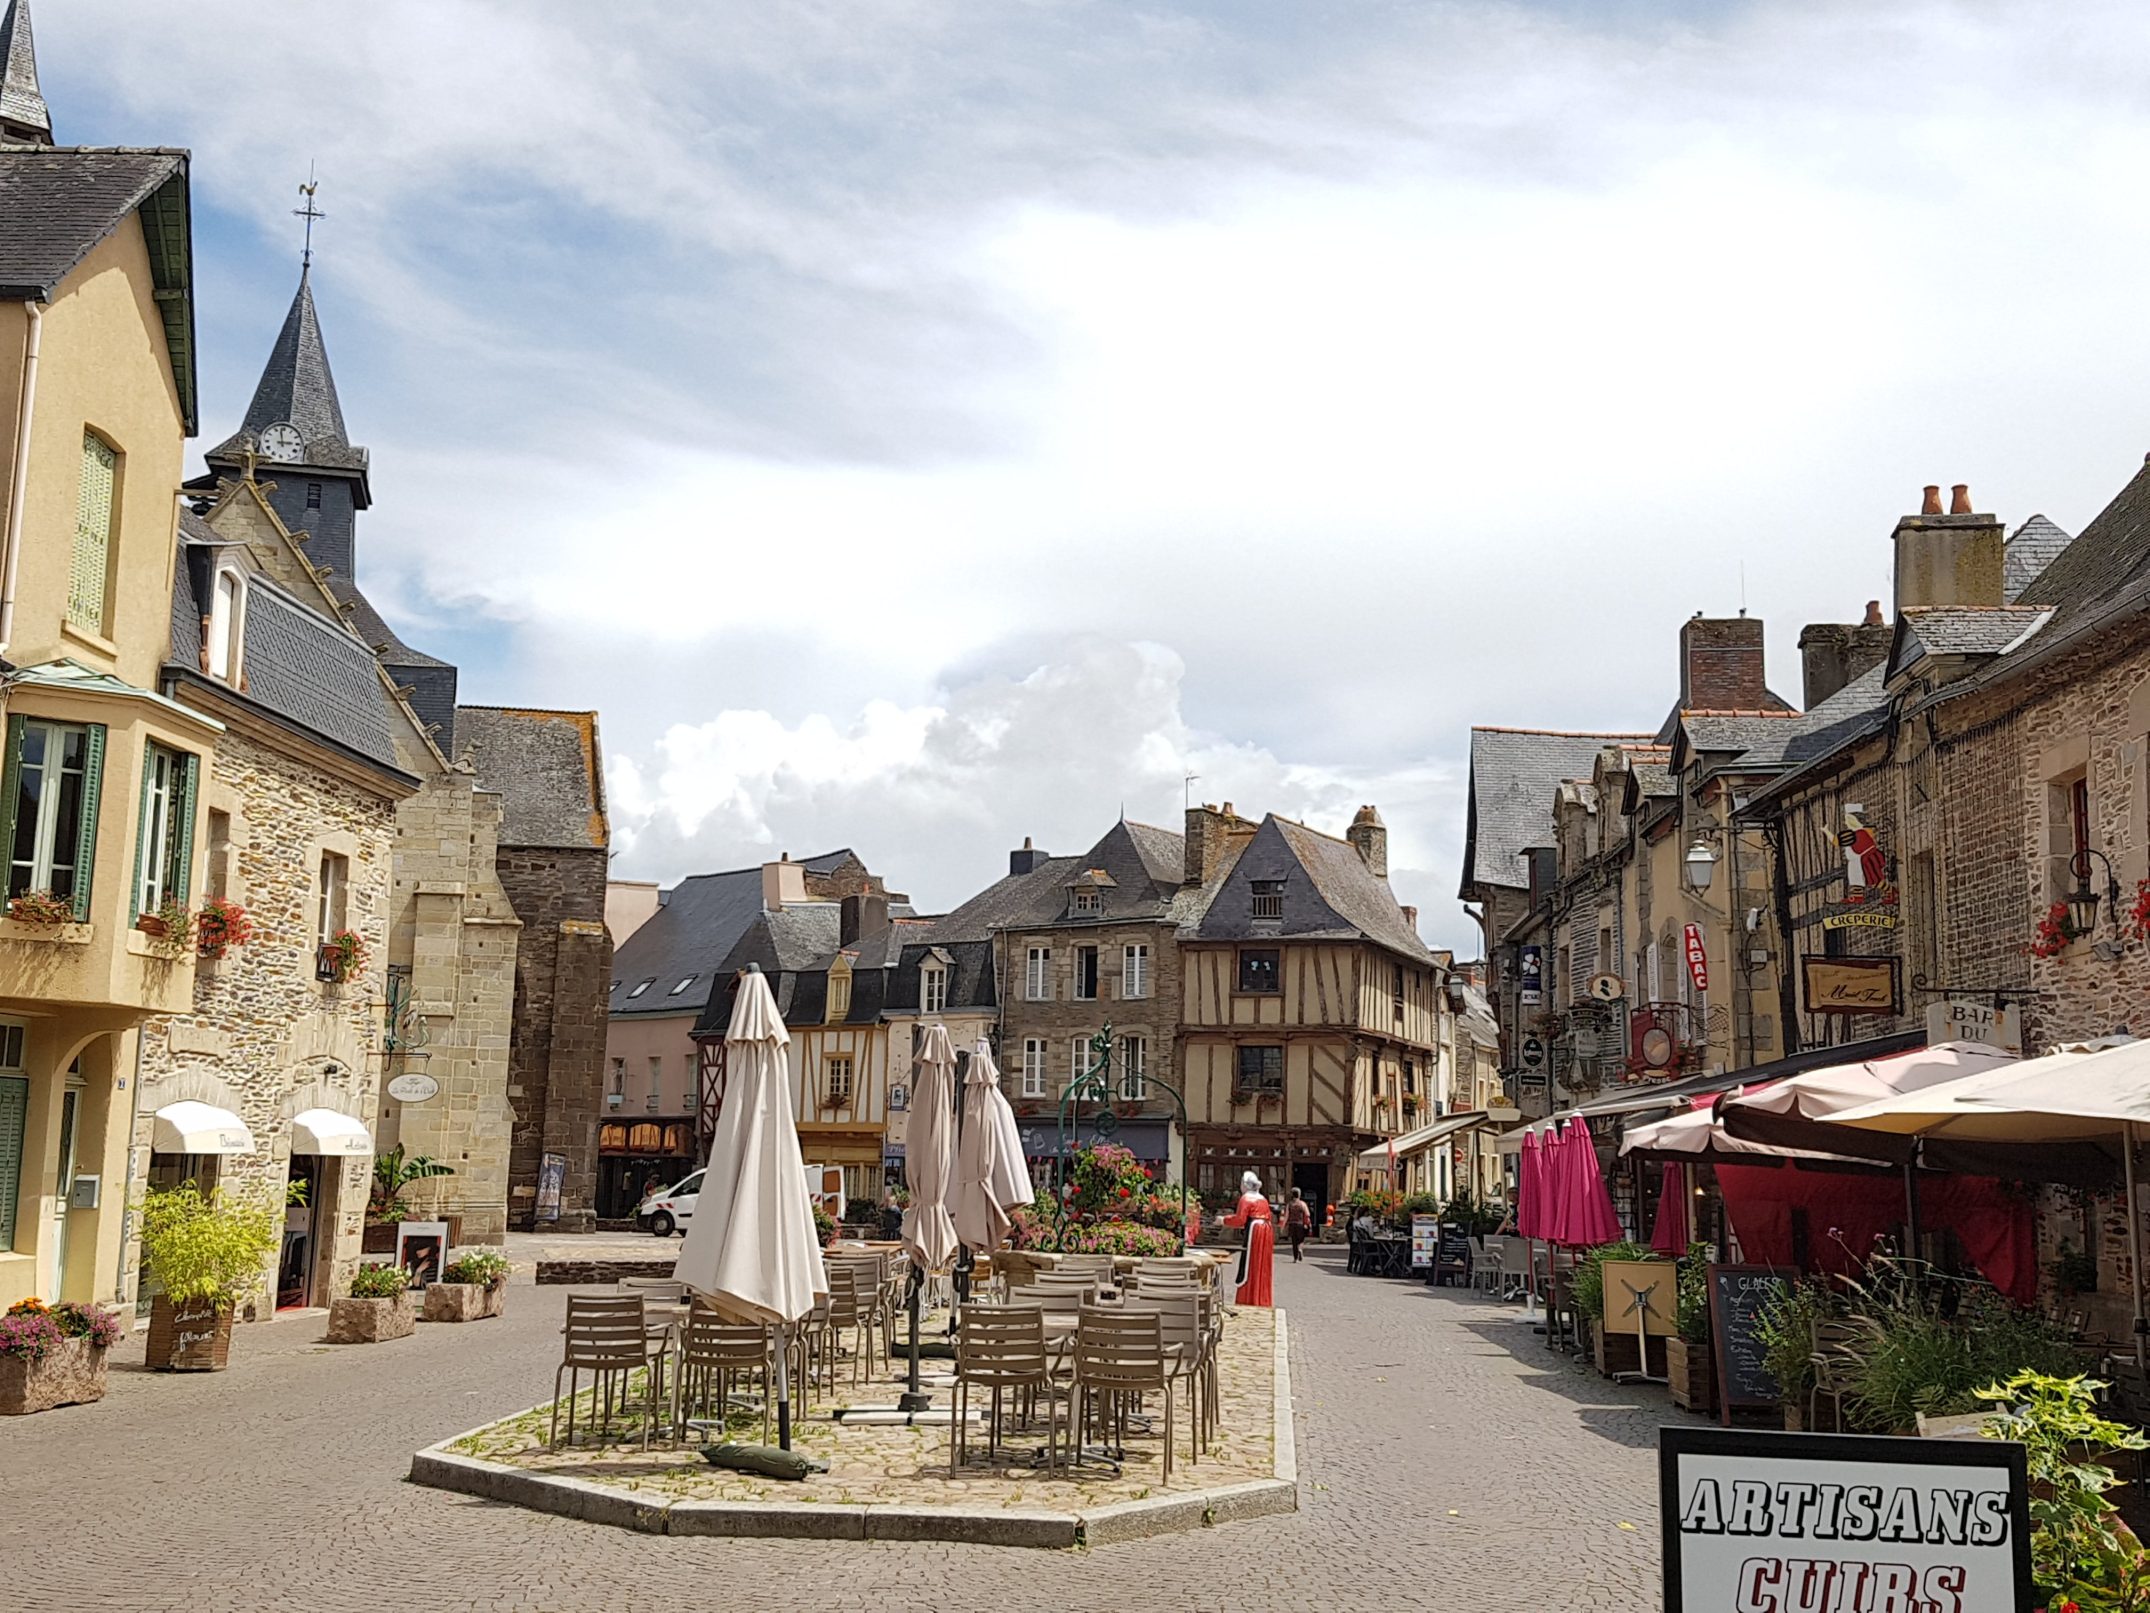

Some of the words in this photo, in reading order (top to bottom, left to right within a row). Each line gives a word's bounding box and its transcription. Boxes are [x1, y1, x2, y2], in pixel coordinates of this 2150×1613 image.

[1830, 914, 1890, 927] CREPERIE
[1685, 925, 1707, 988] TABAC
[1953, 1006, 1994, 1027] BAR
[1960, 1025, 1988, 1041] DU
[1681, 1478, 2010, 1546] ARTISANS
[1736, 1557, 1967, 1613] CUIRS
